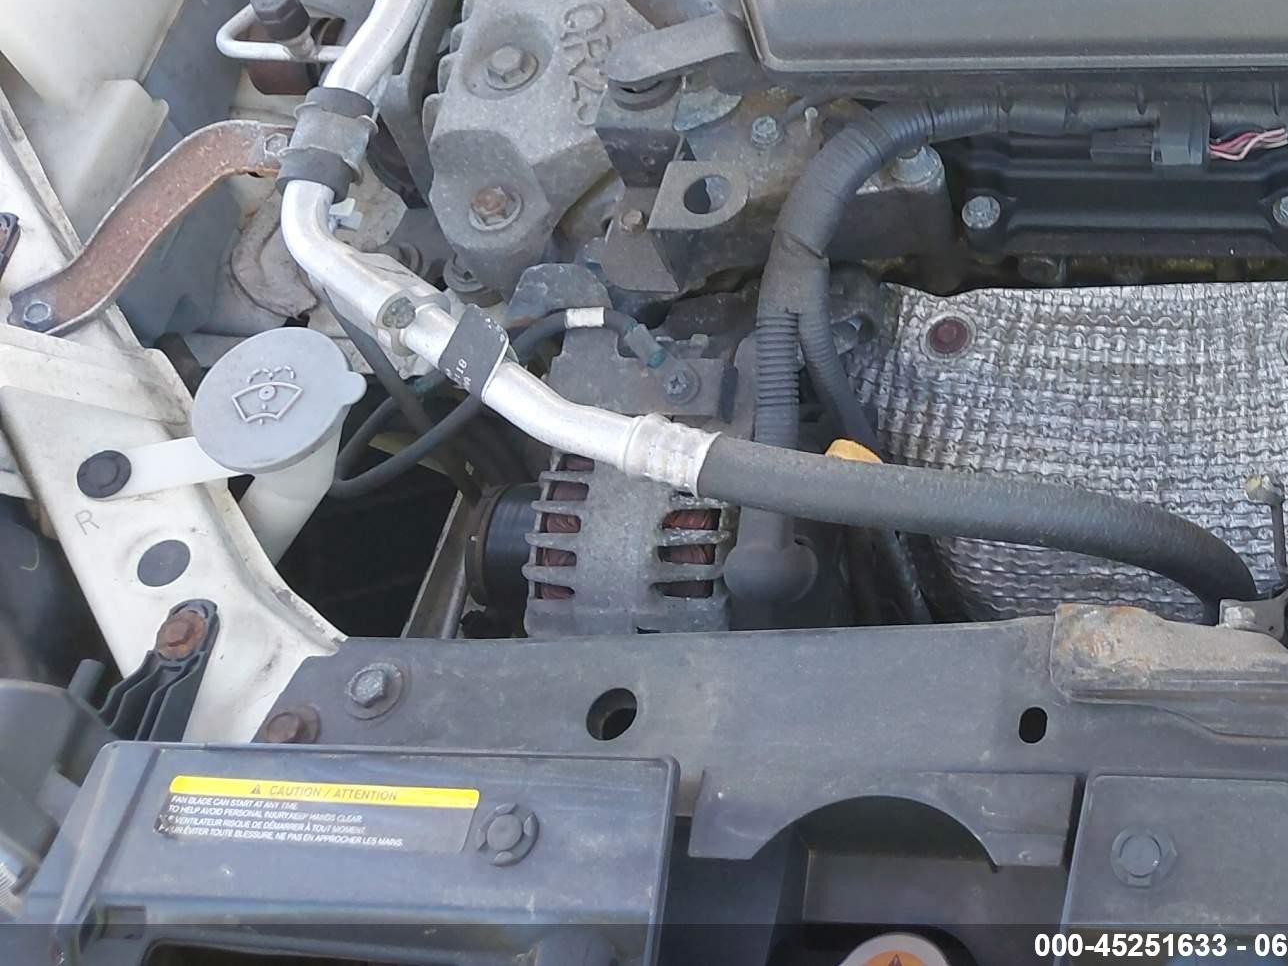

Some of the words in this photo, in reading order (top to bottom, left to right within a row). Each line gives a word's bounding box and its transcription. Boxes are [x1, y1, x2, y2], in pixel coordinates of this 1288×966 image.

[74, 509, 100, 536] R
[269, 785, 320, 797] CAUTION
[333, 789, 398, 801] ATTENTION
[171, 795, 187, 804] FAN
[188, 797, 211, 806] BLADE
[213, 798, 229, 806] CAN
[230, 799, 253, 807] START
[168, 804, 179, 812] TO
[180, 805, 199, 813] HELP
[199, 807, 223, 815] AVOID
[223, 809, 262, 818] PERSONAL
[251, 821, 263, 829] DE
